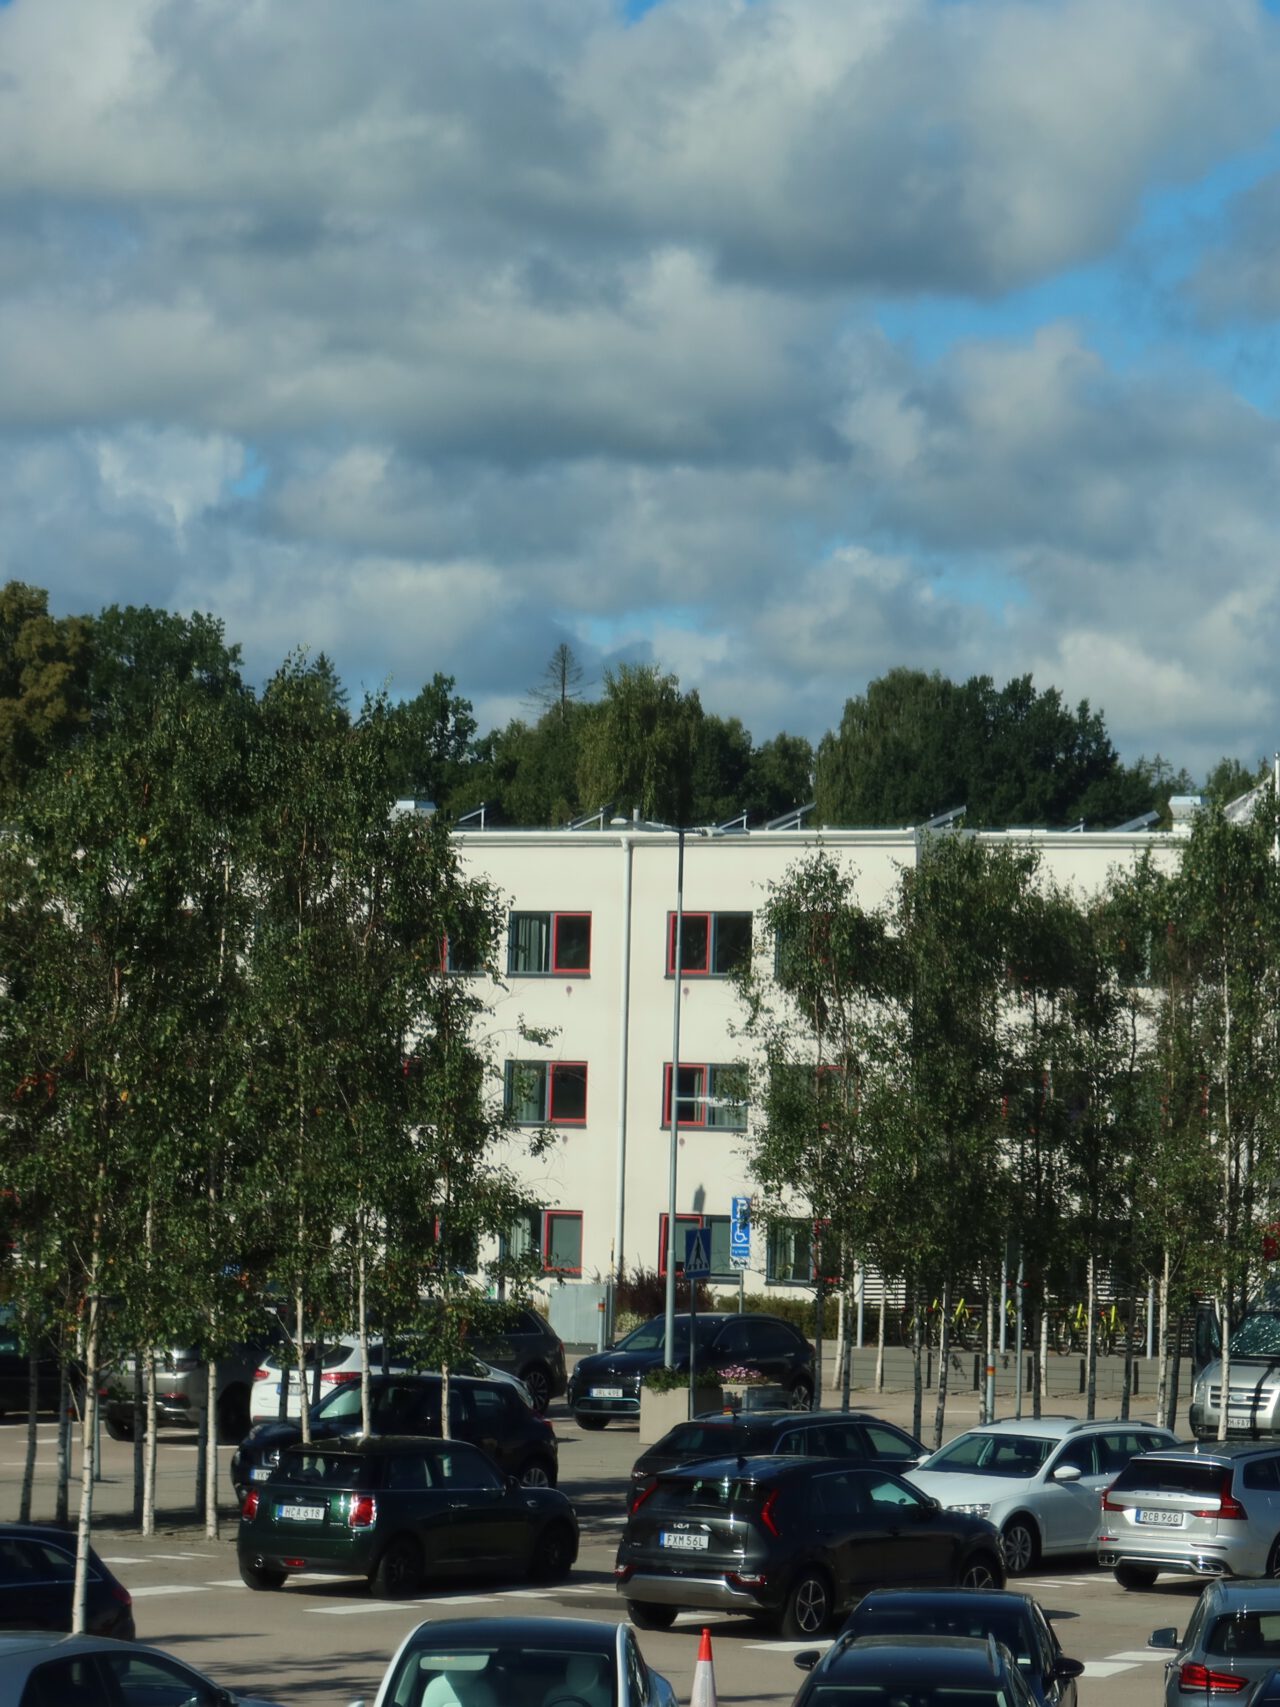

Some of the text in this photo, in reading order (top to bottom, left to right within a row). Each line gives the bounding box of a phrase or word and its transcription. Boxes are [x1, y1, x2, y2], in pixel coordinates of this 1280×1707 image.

[285, 1507, 320, 1518] HCA 618
[1142, 1511, 1159, 1521] RCB
[667, 1534, 704, 1547] FXM 56L
